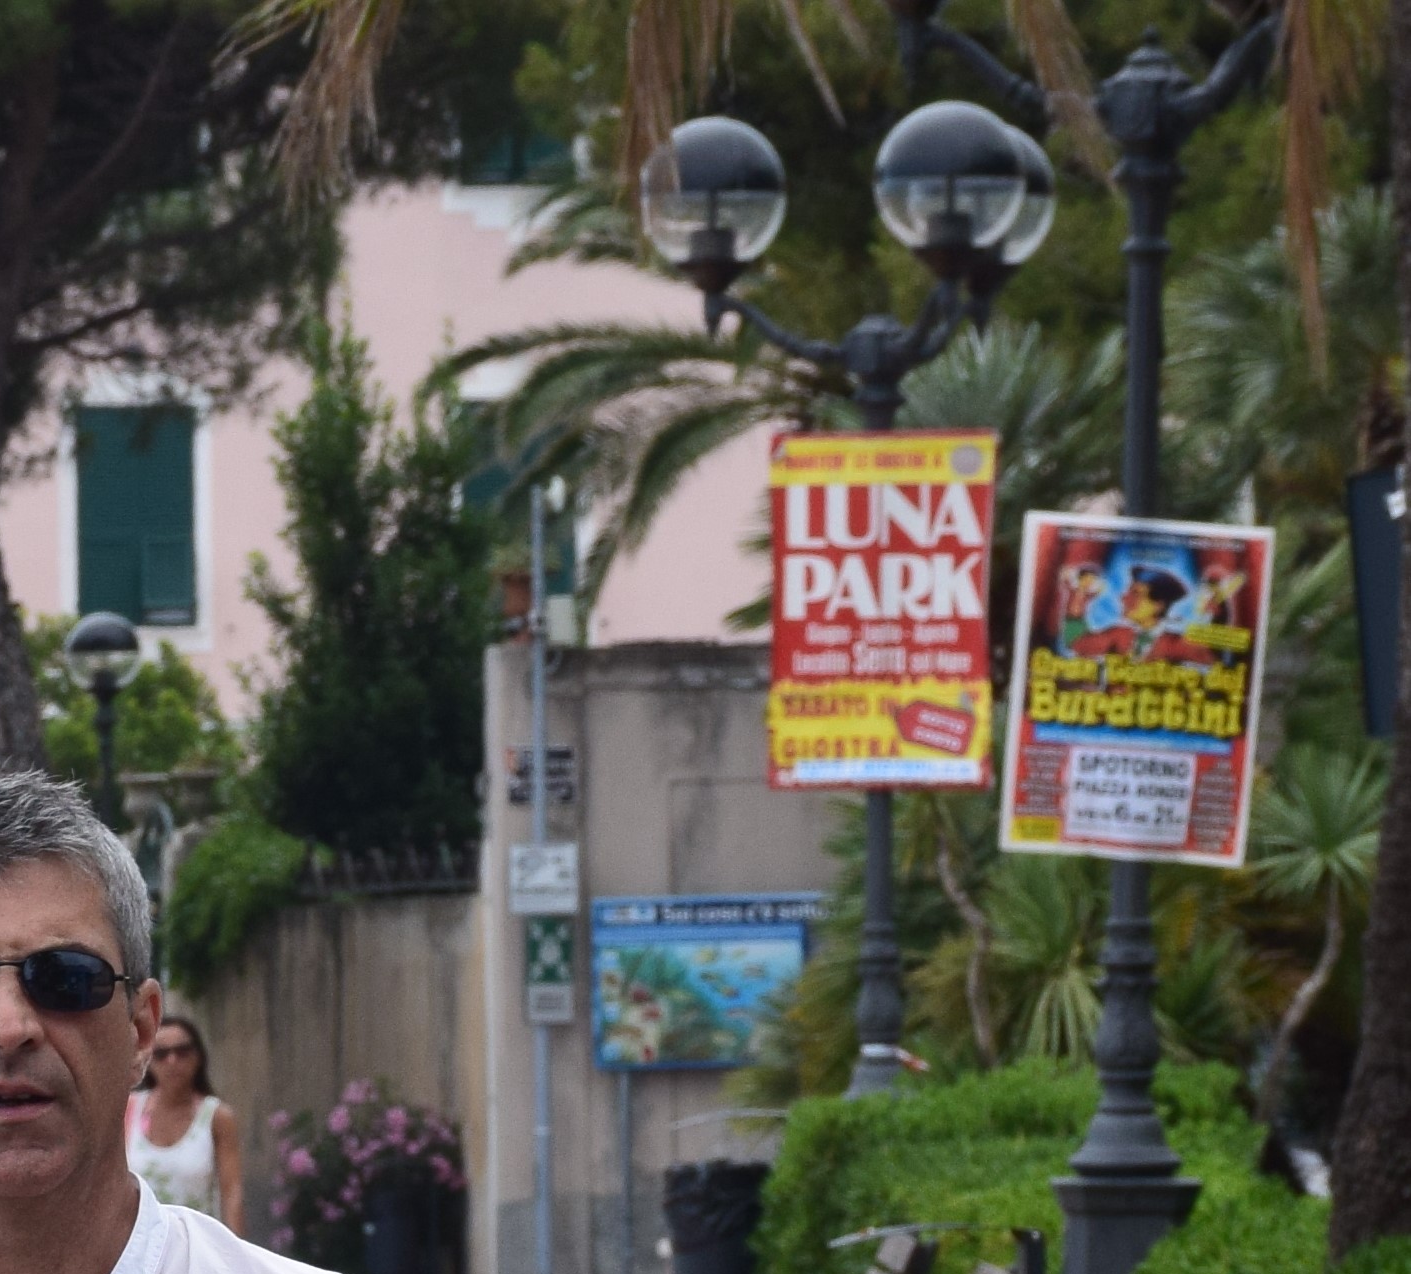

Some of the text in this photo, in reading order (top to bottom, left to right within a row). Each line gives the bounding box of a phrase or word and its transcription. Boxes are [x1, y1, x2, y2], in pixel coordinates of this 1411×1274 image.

[784, 484, 984, 549] LUNA
[781, 553, 983, 620] PARK
[1030, 677, 1243, 738] Burattini
